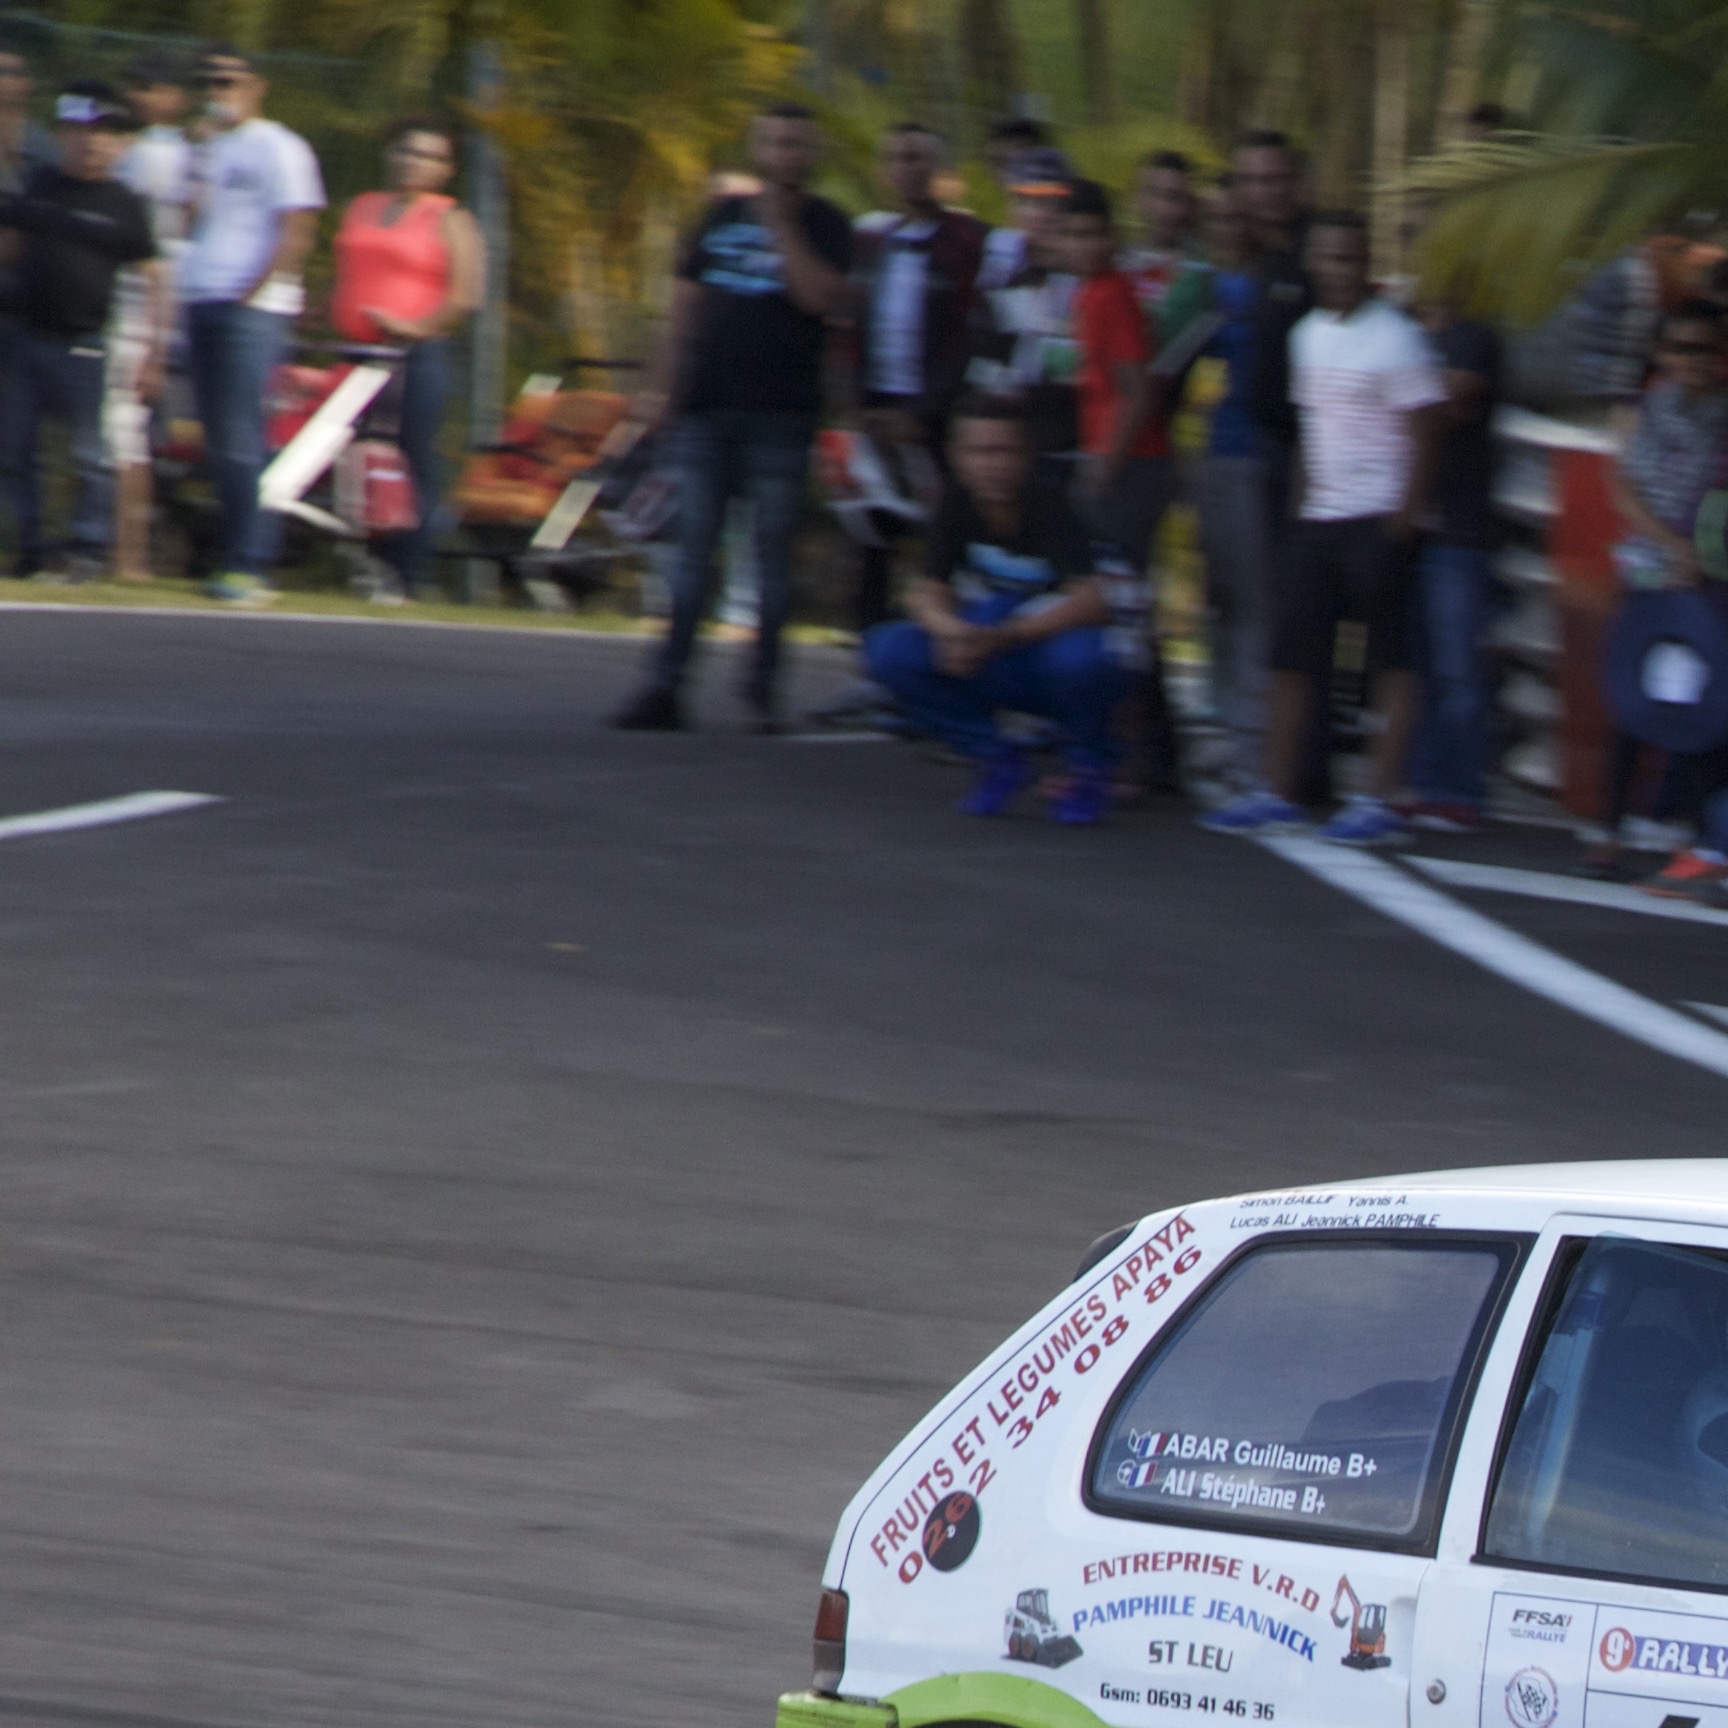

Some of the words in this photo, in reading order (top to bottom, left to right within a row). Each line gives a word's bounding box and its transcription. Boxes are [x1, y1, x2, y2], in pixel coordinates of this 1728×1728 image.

[1229, 1213, 1271, 1230] Lucas
[1272, 1213, 1298, 1227] ALI
[1301, 1213, 1362, 1228] Jeannick
[1364, 1213, 1441, 1228] PAMPHILE
[1240, 1195, 1282, 1209] Simon
[1348, 1195, 1391, 1207] Yannis
[869, 1457, 956, 1569] FRUITS
[951, 1415, 987, 1468] ET
[986, 1293, 1109, 1428] LEGUMES
[1110, 1215, 1197, 1304] APAYA
[897, 1458, 999, 1585] 0262
[1005, 1384, 1063, 1450] 34
[1072, 1314, 1131, 1376] 08
[1143, 1245, 1204, 1305] 86
[1163, 1432, 1230, 1463] ABAR
[1233, 1440, 1341, 1476] Guillaume
[1346, 1452, 1378, 1479] B+
[1160, 1467, 1196, 1498] ALI
[1199, 1472, 1298, 1511] Stéphane
[1300, 1485, 1327, 1515] B+
[1083, 1551, 1244, 1586] ENTREPRISE
[1252, 1563, 1321, 1613] V.R.D
[1072, 1595, 1197, 1633] PAMPHILE
[1202, 1599, 1320, 1664] JEANNICK
[1512, 1608, 1565, 1628] FFSA
[1527, 1629, 1567, 1643] RALLYE
[1148, 1640, 1180, 1665] ST
[1186, 1641, 1234, 1674] LEU
[1100, 1682, 1141, 1704] Gsm:
[1146, 1688, 1192, 1711] 0693
[1197, 1695, 1217, 1713] 41
[1223, 1699, 1248, 1718] 46
[1252, 1701, 1276, 1722] 36
